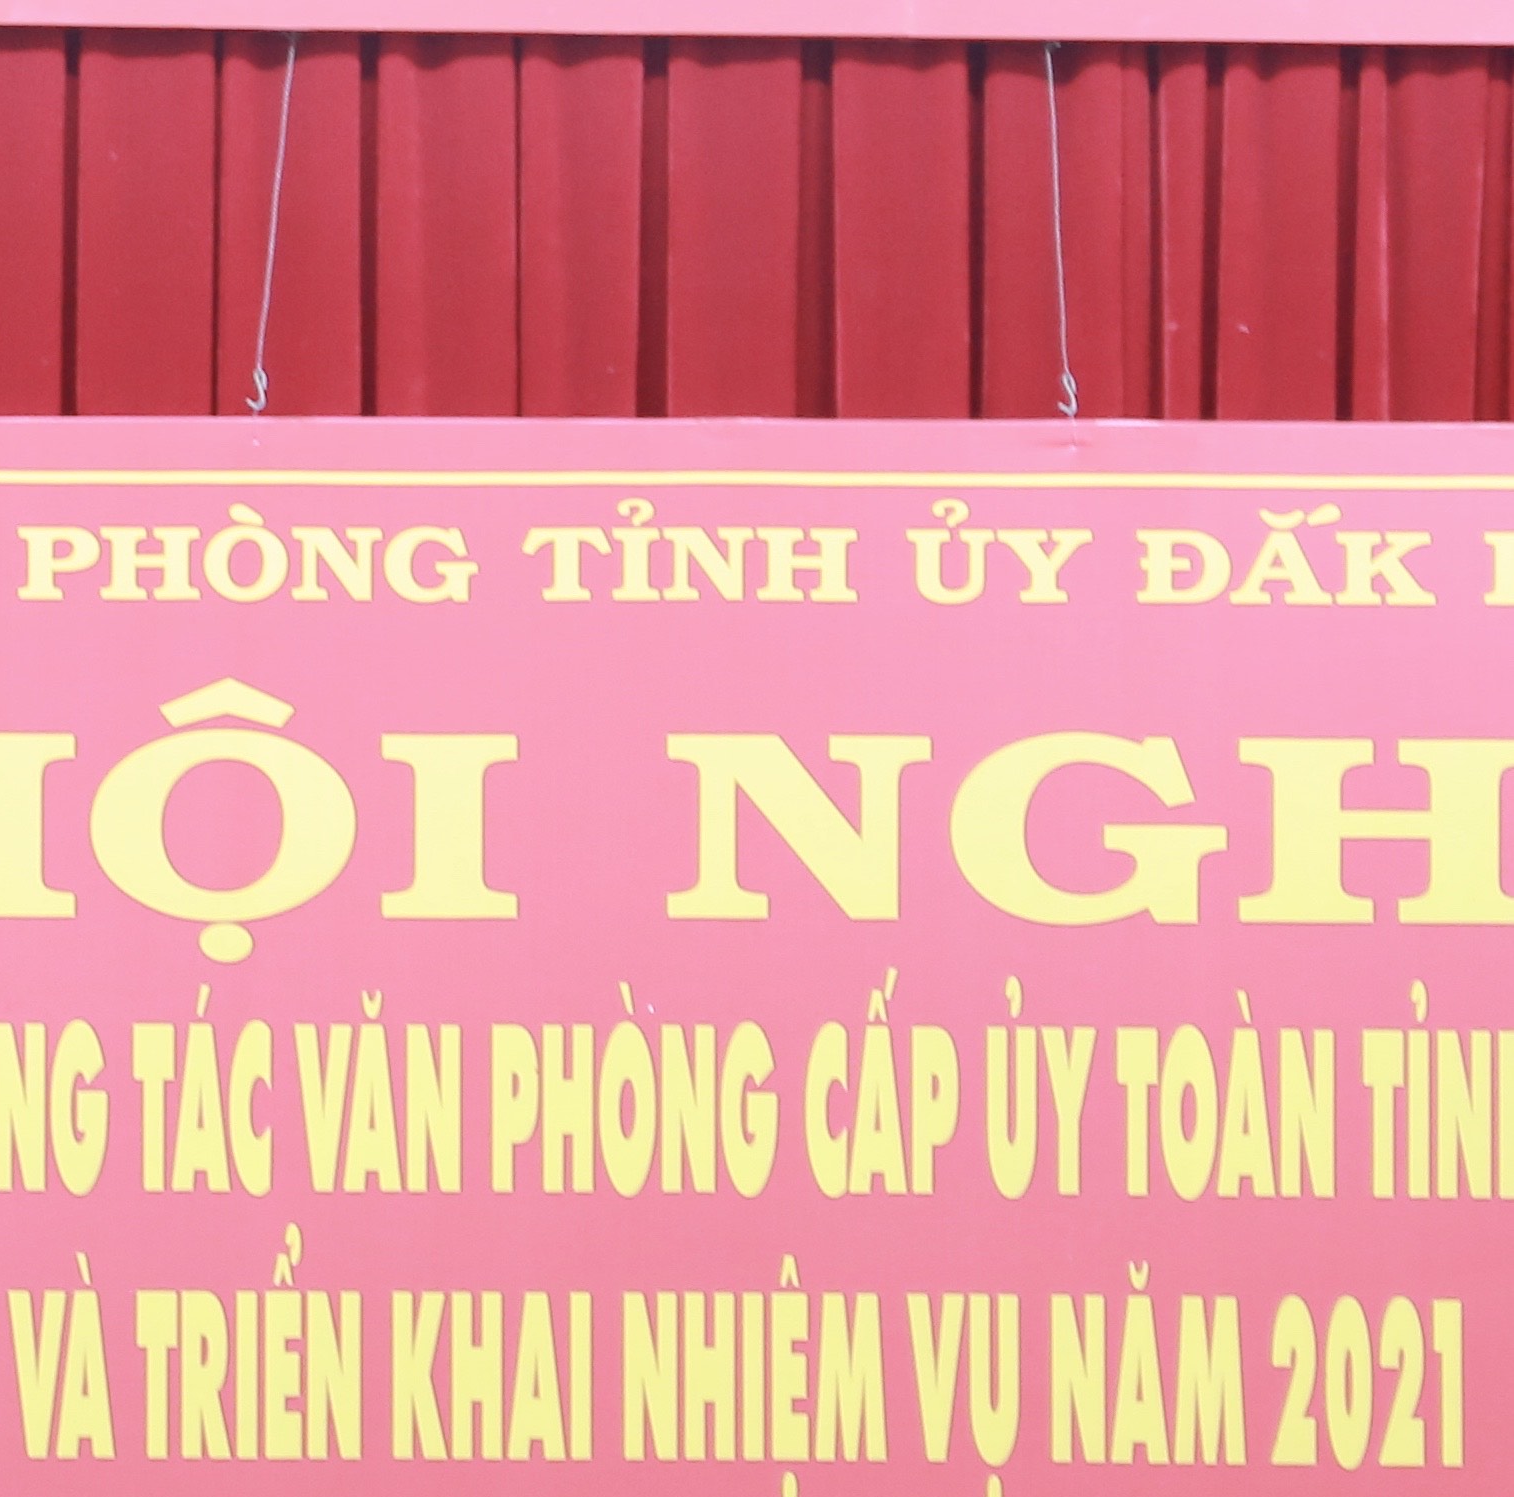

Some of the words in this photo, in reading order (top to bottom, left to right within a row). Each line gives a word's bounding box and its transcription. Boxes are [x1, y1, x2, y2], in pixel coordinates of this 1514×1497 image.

[16, 500, 479, 604] PHÒNG
[521, 497, 858, 603] TỈNH
[904, 496, 1094, 605] ỦY
[1134, 502, 1437, 607] ĐẮK
[665, 729, 1514, 926] NGH
[132, 982, 272, 1197] TÁC
[293, 984, 461, 1193] VĂN
[491, 980, 779, 1198] PHÒNG
[804, 965, 959, 1199] CẤP
[985, 974, 1097, 1200] ỦY
[1115, 984, 1335, 1201] TOÀN
[7, 1250, 115, 1459] VÀ
[135, 1221, 362, 1460] TRIỂN
[391, 1290, 592, 1461] KHAI
[1050, 1257, 1246, 1465] NĂM
[1270, 1294, 1464, 1470] 2021
